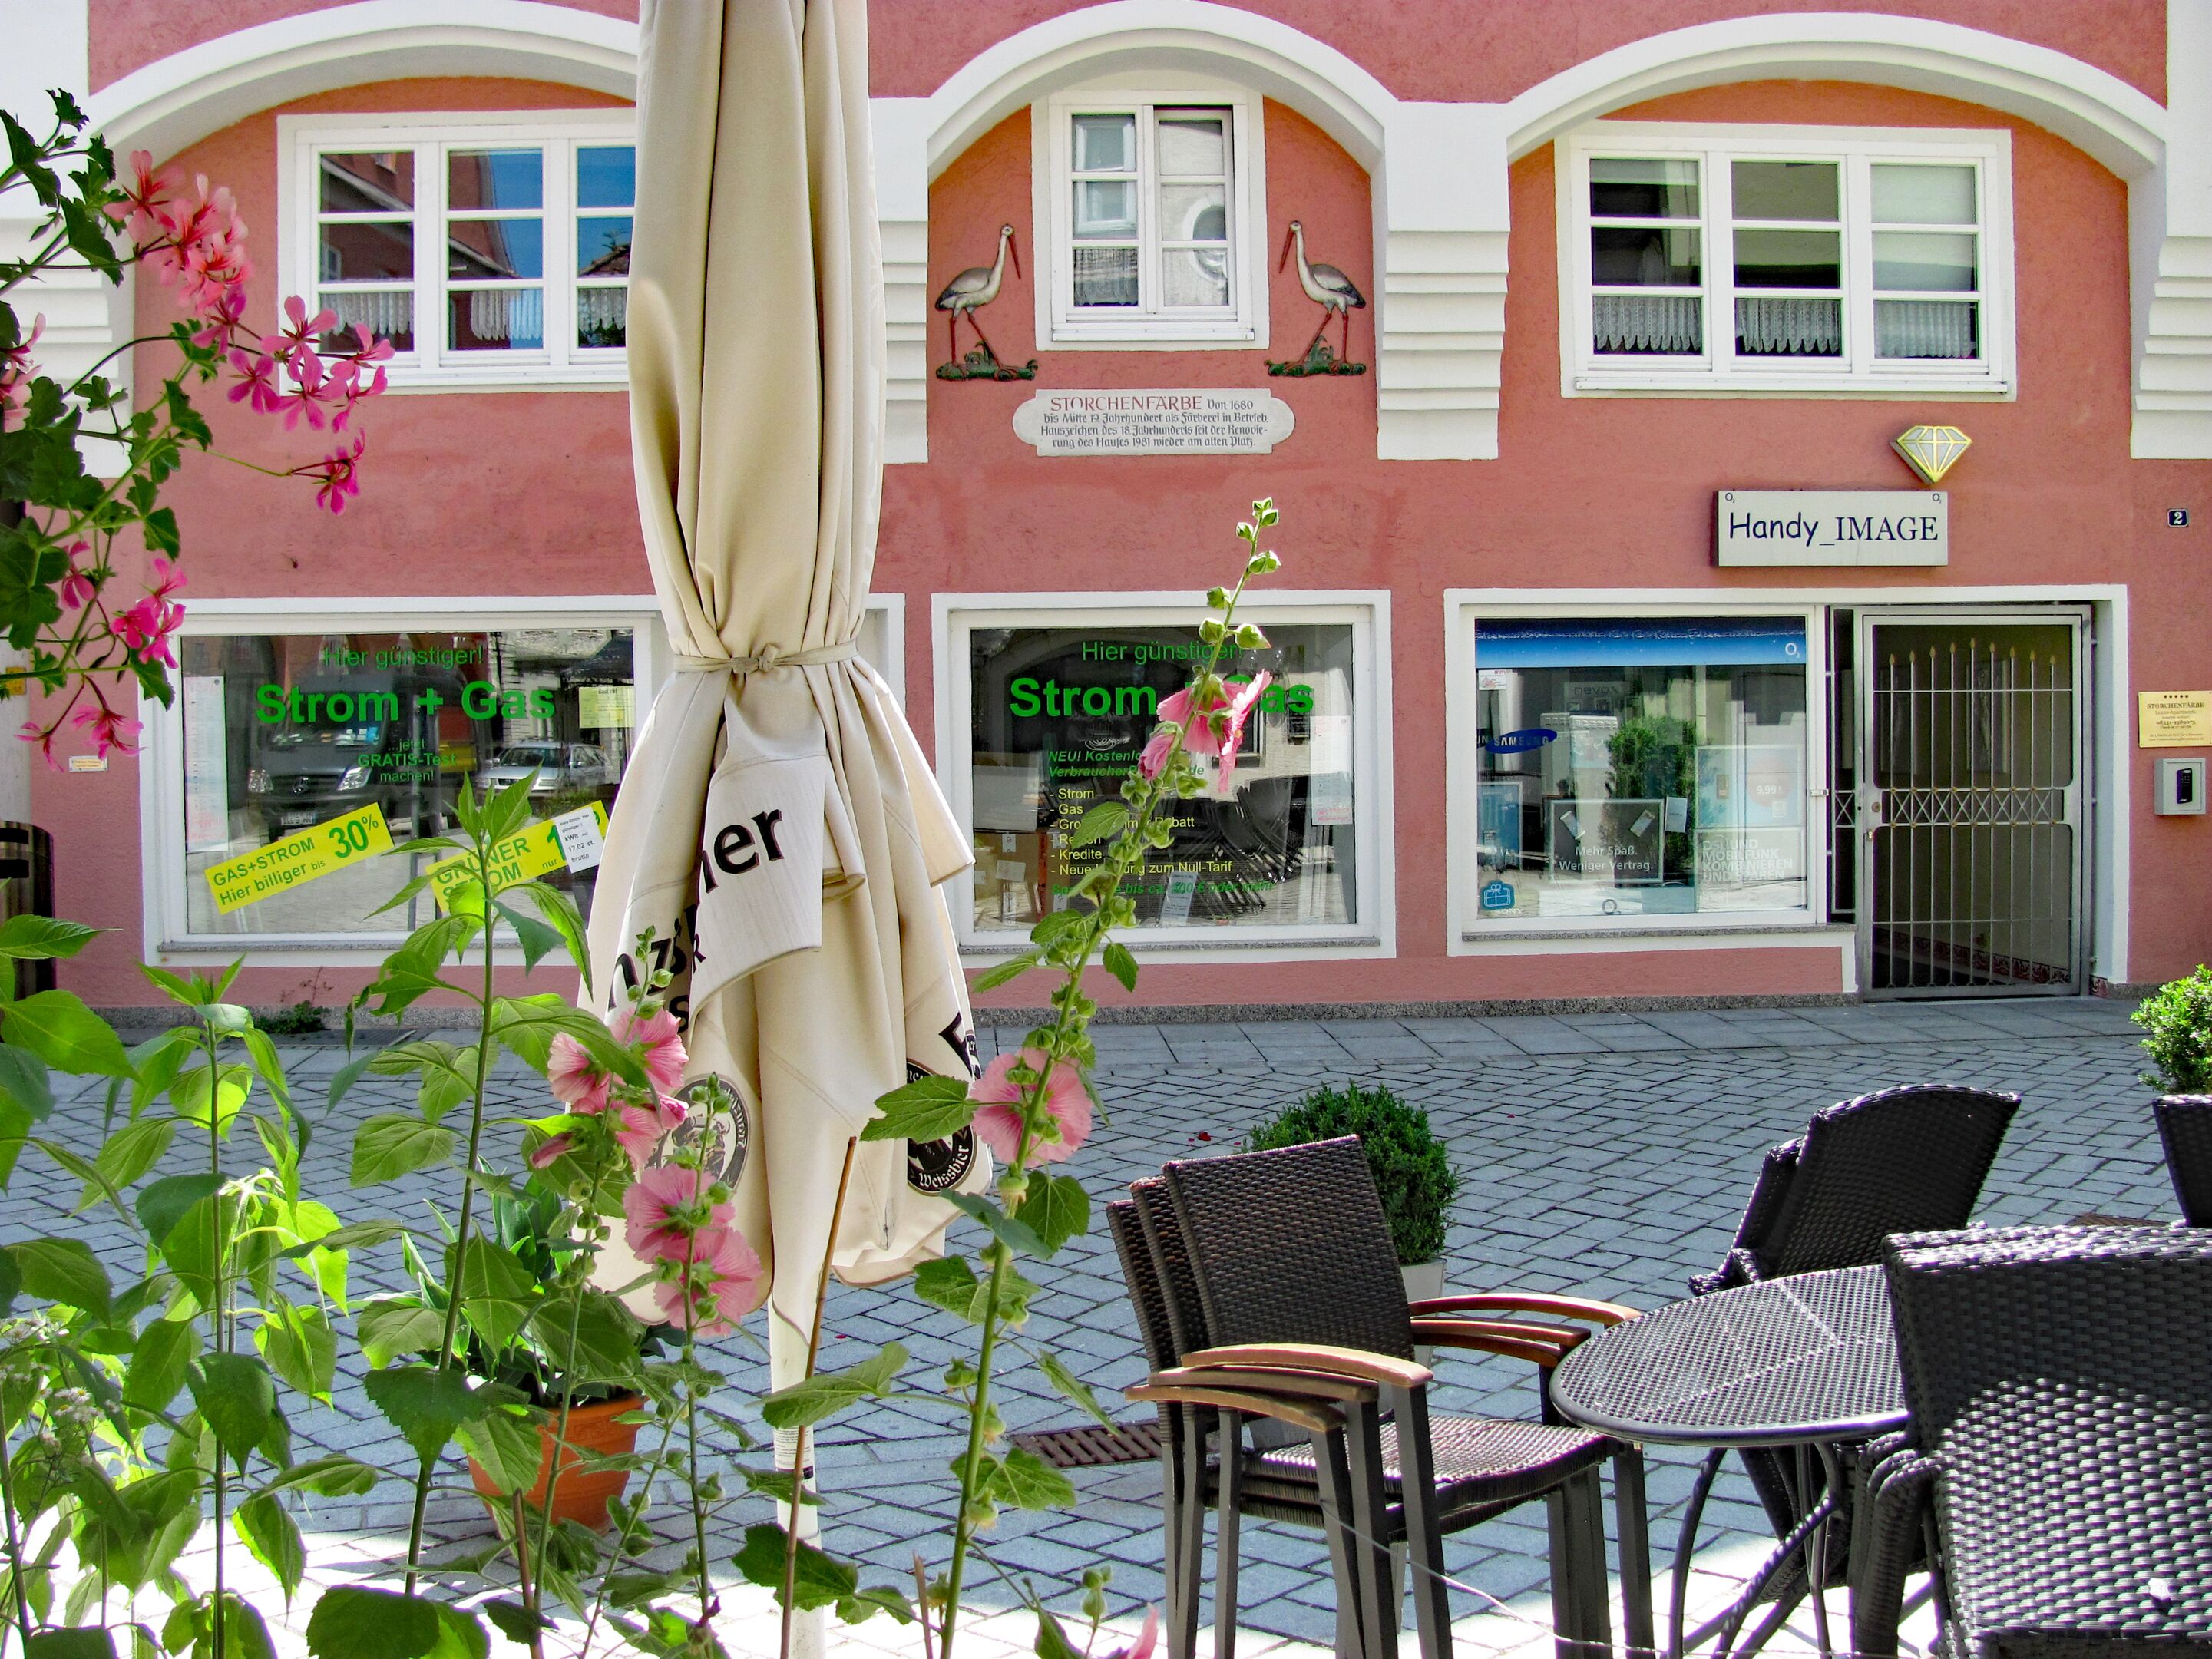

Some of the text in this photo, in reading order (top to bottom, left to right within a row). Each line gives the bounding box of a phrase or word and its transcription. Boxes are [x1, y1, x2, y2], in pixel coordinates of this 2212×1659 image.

[1050, 395, 1202, 411] STORCHENFÄRBE
[1230, 400, 1254, 410] 1680
[1044, 413, 1059, 423] bis
[1063, 413, 1087, 423] Mitte
[1102, 412, 1162, 425] Jahrhundert
[1165, 414, 1179, 423] als
[1222, 413, 1232, 423] in
[1233, 412, 1269, 423] Betrieb.
[1041, 425, 1099, 437] Hauszeichen
[1102, 425, 1118, 435] des
[1132, 425, 1192, 437] Jahrhunderts
[1210, 425, 1226, 435] der
[1052, 438, 1075, 449] rung
[1077, 438, 1093, 447] des
[1132, 438, 1150, 447] 1981
[1153, 437, 1184, 447] wieder
[1187, 438, 1202, 446] am
[1204, 437, 1228, 446] alten
[2174, 511, 2183, 525] 2
[324, 645, 484, 670] Hier günstiger!
[1083, 641, 1127, 662] Hier
[255, 684, 399, 724] Strom
[461, 680, 556, 721] Gas
[1010, 674, 1314, 718] Strom as
[358, 752, 456, 768] GRATIS-Test
[1049, 750, 1081, 762] NEU!
[380, 769, 435, 782] machen!
[1058, 788, 1095, 800] Strom
[1756, 785, 1778, 795] 9,99
[1059, 804, 1083, 815] Gas
[1154, 816, 1195, 828] Rbatt
[1060, 848, 1103, 861] Kredite
[1575, 844, 1638, 858] Mehr Spaß.
[1702, 848, 1780, 861] MOBILFUNK
[213, 837, 316, 886] GAS+STROM
[220, 813, 379, 906] Hier billiger bis 30%
[542, 859, 557, 869] nur
[571, 853, 590, 863] brutto
[1060, 863, 1090, 875] Neue
[1149, 862, 1175, 874] zum
[1178, 861, 1232, 873] Null-Tarif
[1559, 860, 1653, 873] Weniger Vertrag.
[1702, 858, 1794, 872] KOMBINIEREN
[1125, 882, 1144, 894] bis
[1208, 881, 1238, 893] oder
[918, 1144, 970, 1189] Weissbier
